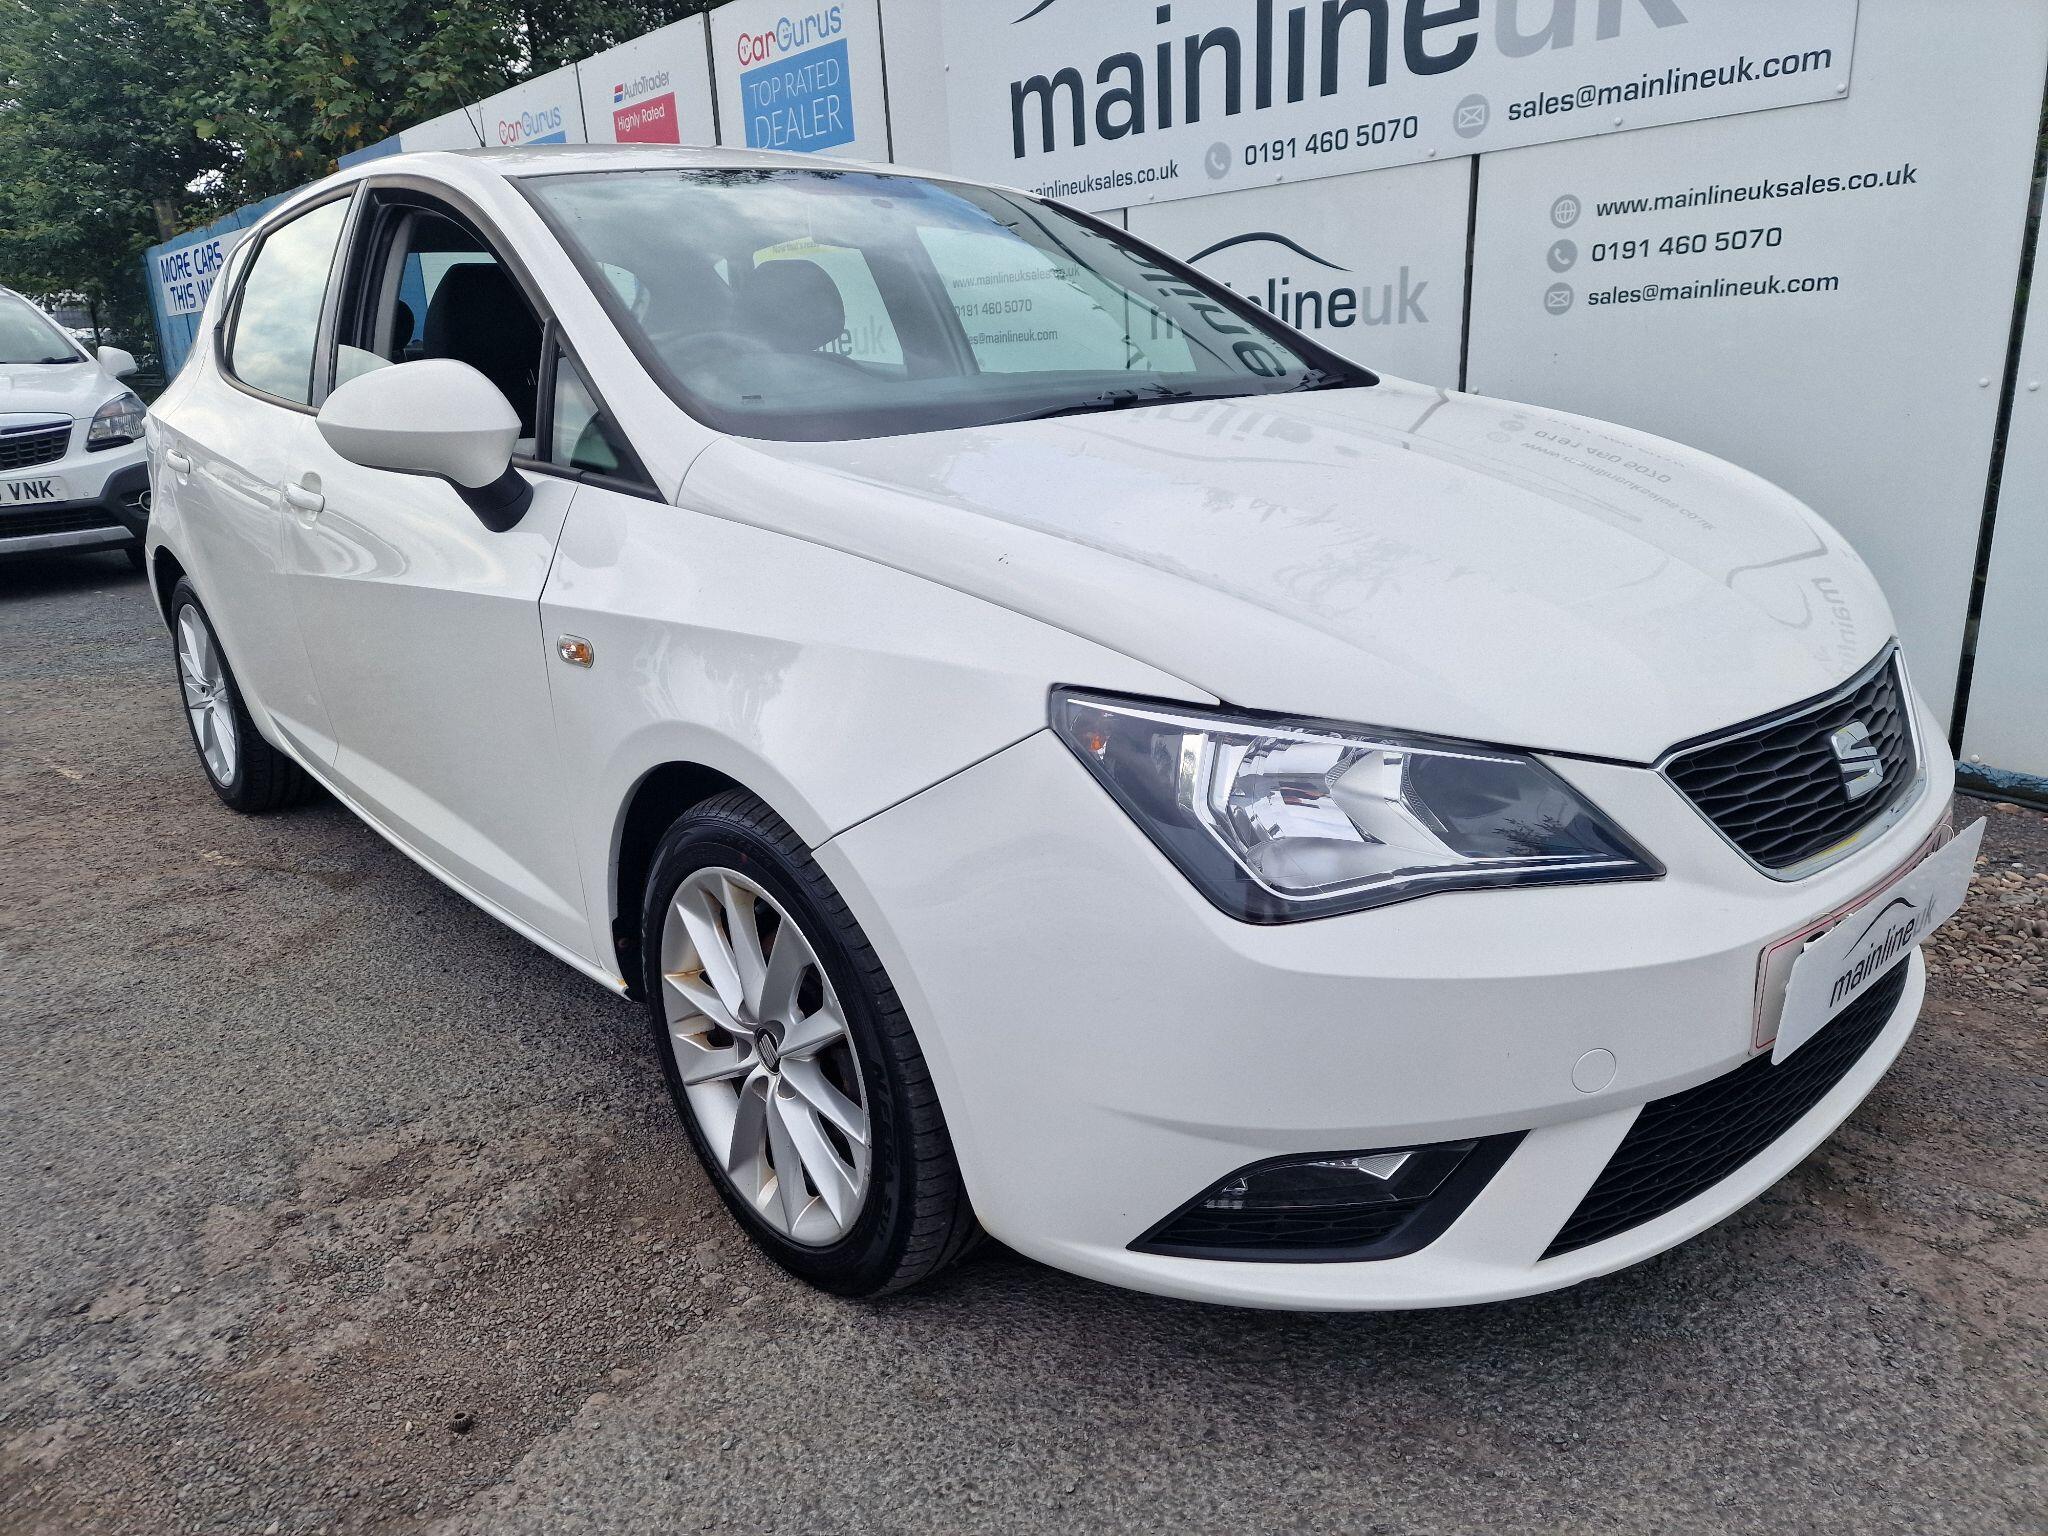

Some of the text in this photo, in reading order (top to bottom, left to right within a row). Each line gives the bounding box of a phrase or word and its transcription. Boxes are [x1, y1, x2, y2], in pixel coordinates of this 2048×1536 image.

[738, 6, 842, 66] CarGurus
[623, 70, 670, 100] AutoTrader
[750, 59, 839, 109] TOP RATED
[1010, 0, 1688, 158] mainlineu
[498, 106, 562, 145] CarGurus
[618, 103, 665, 132] Highly Rated
[755, 95, 843, 150] DEALER
[1026, 48, 1833, 199] ainlineuksales.co.uk 0191 460 5070 sales@mainlineuk.com
[1596, 162, 1918, 216] www.mainlineuksales.co.uk
[161, 241, 224, 283] MORE CARS
[1592, 227, 1783, 262] 0191 460 5070
[170, 283, 197, 311] THIS
[982, 301, 1002, 315] 460
[1004, 299, 1033, 313] 5070
[1588, 275, 1839, 306] sales@mainlineuk.com
[7, 481, 54, 500] VNK
[1829, 887, 1937, 1008] mainlineuk
